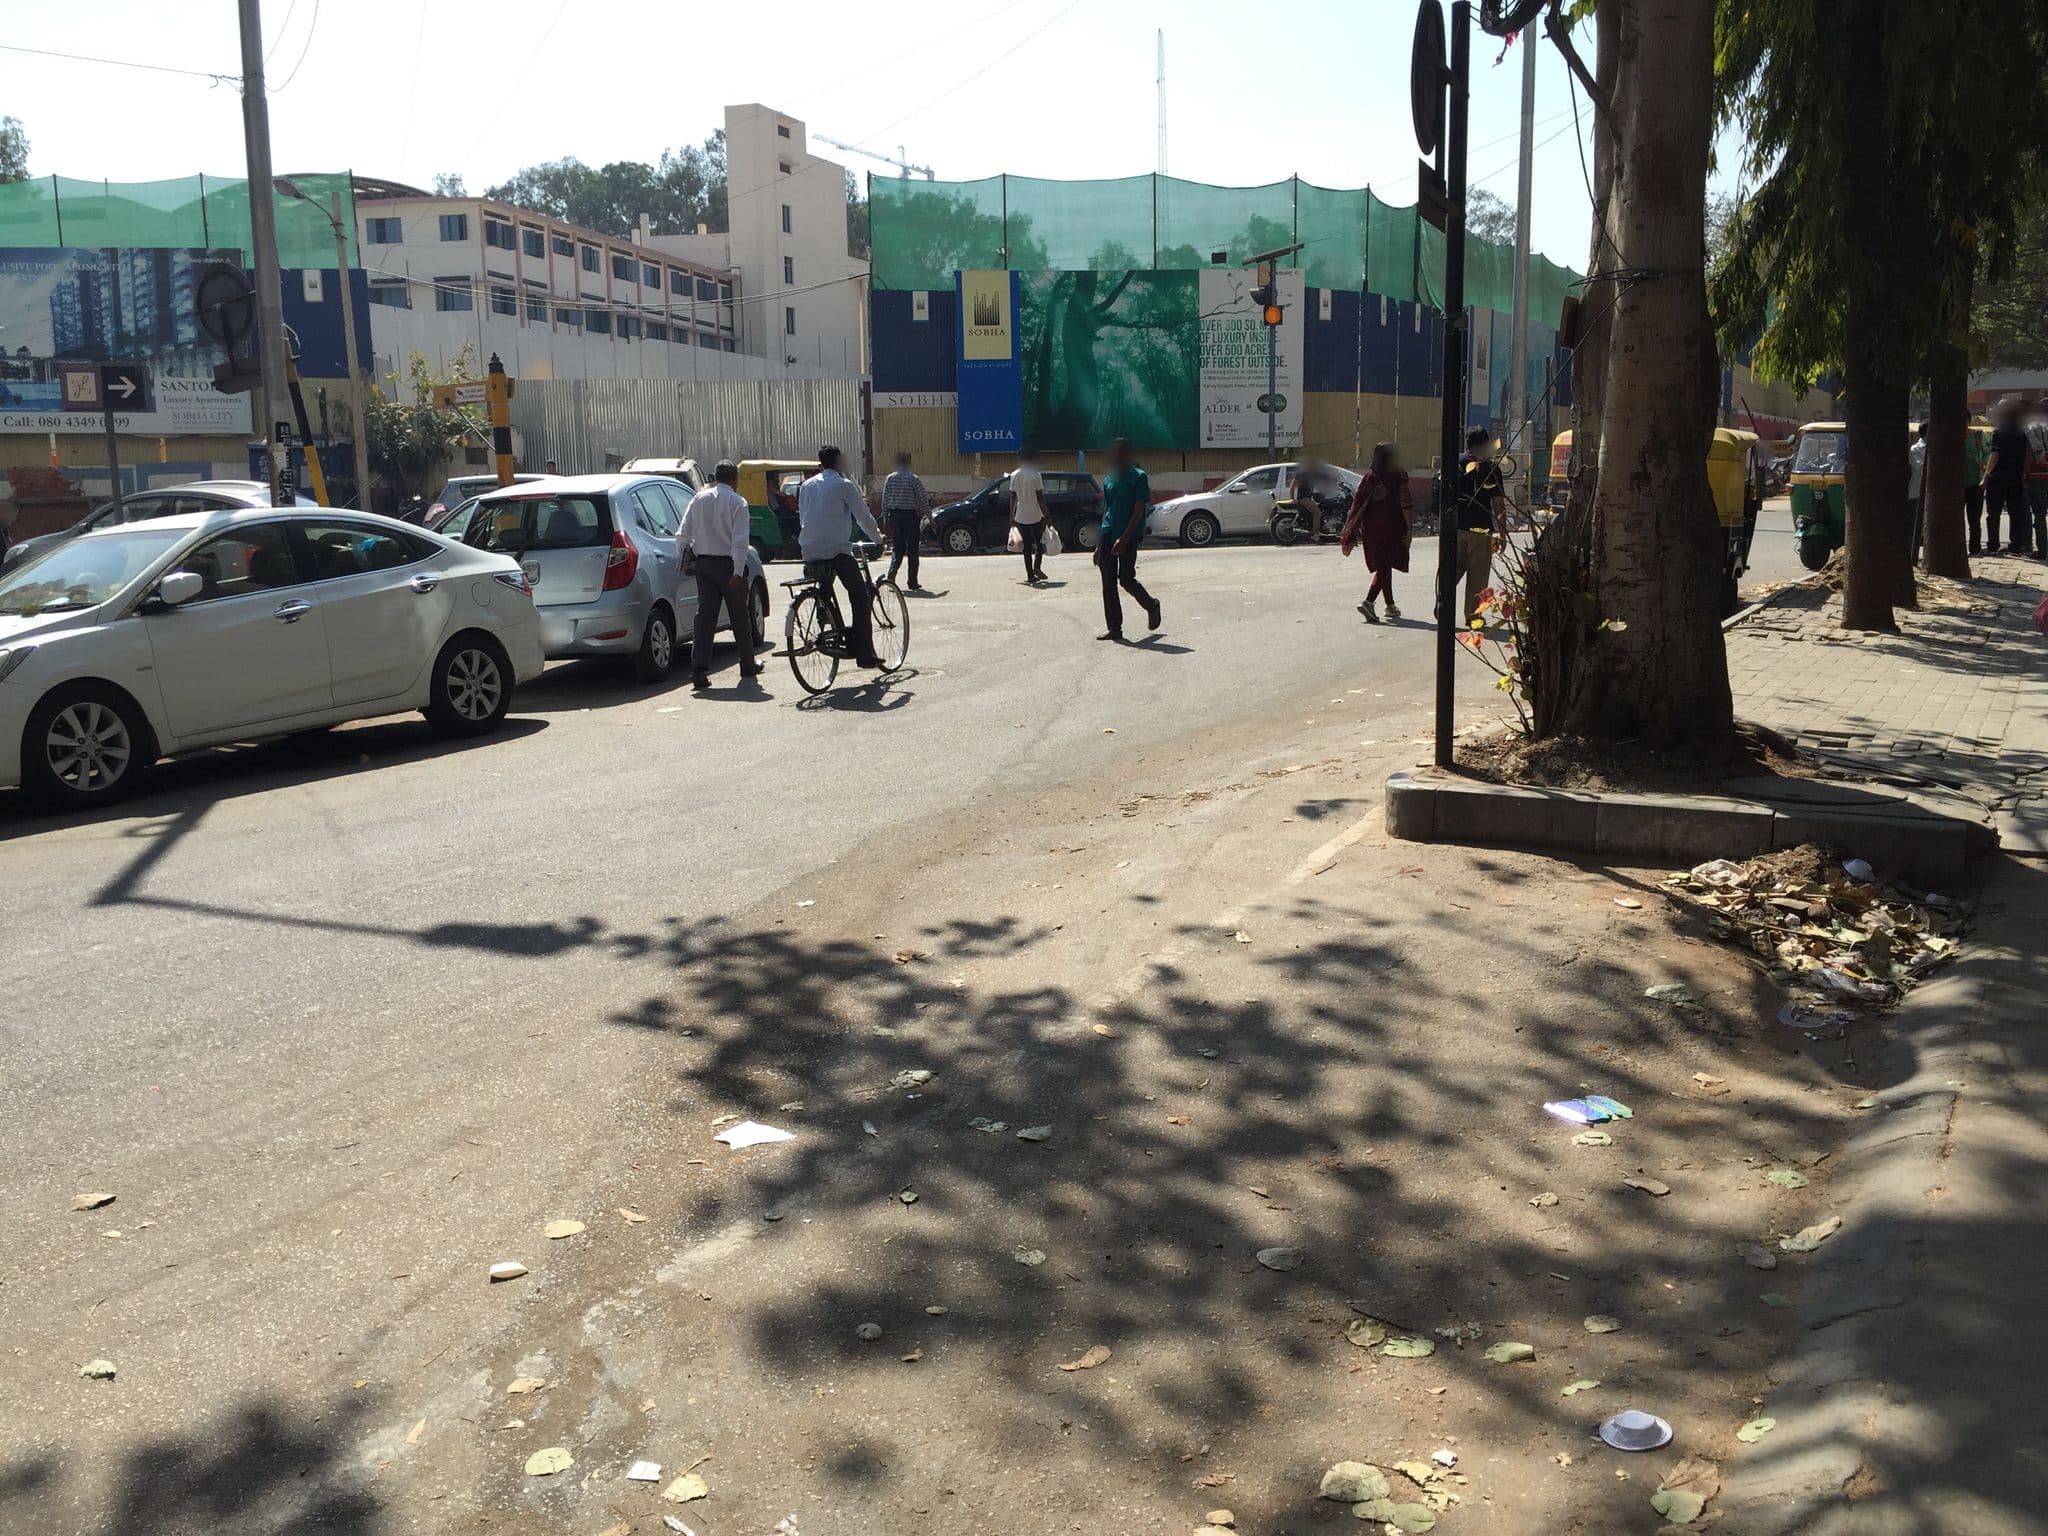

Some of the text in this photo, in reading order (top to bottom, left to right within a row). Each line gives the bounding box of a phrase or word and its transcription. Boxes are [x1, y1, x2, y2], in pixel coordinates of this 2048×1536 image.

[1200, 320, 1222, 331] OVER
[1225, 320, 1242, 331] 300
[968, 328, 1006, 337] SOBHA
[1200, 332, 1210, 343] OF
[1212, 332, 1247, 343] LUXURY
[1200, 344, 1222, 356] OVER
[1225, 344, 1243, 356] 500
[1200, 357, 1210, 368] OF
[1212, 357, 1245, 368] FOREST
[163, 396, 242, 405] Luxury Apartments
[1203, 404, 1240, 413] ALDER
[4, 416, 130, 428] Call: 080 4349 099
[172, 412, 234, 421] SOBHA CITY
[964, 430, 1015, 441] SOBHA
